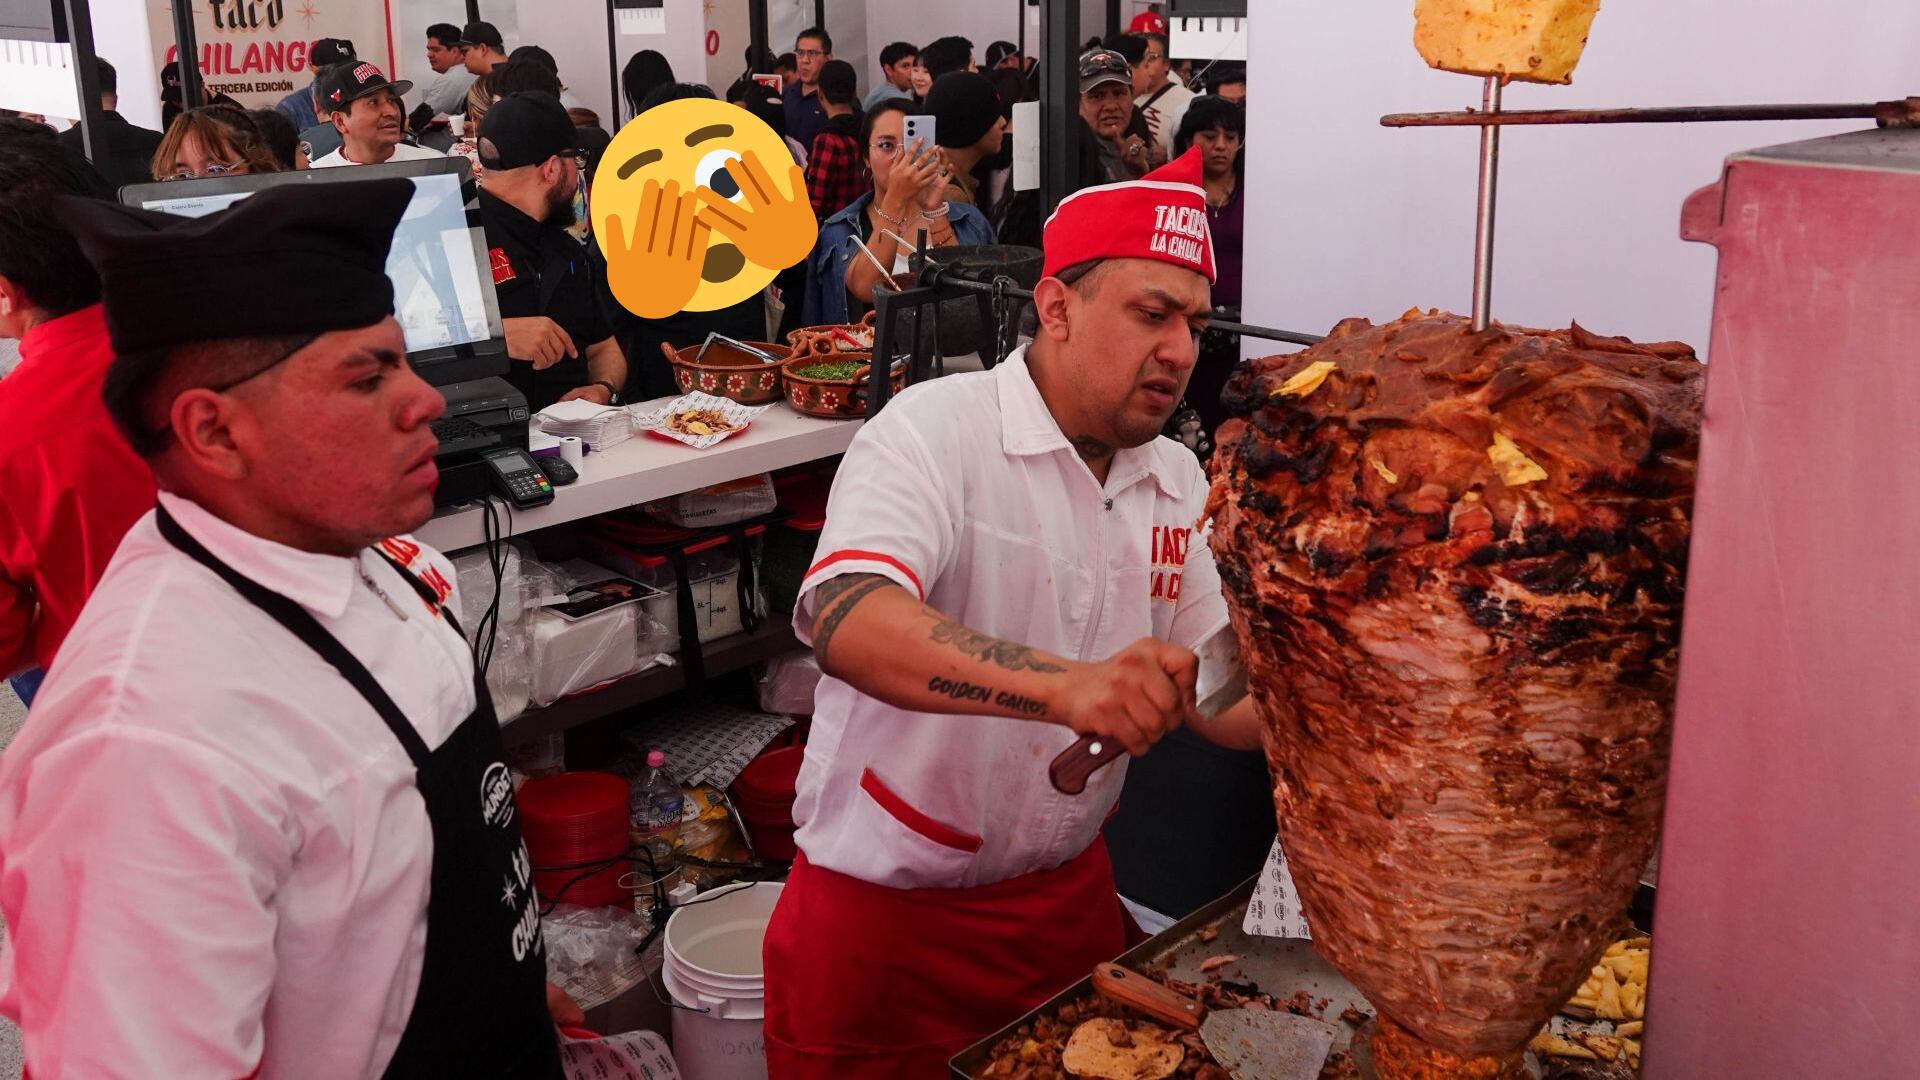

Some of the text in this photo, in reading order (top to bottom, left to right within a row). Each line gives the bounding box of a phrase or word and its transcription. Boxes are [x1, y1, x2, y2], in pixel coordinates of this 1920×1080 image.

[164, 40, 320, 76] HILANG
[208, 79, 293, 95] TERCERA EDICIÓN
[1150, 233, 1204, 265] LA CHULA
[1151, 525, 1192, 567] TAC
[928, 676, 1048, 717] GOLDEN GALLOS
